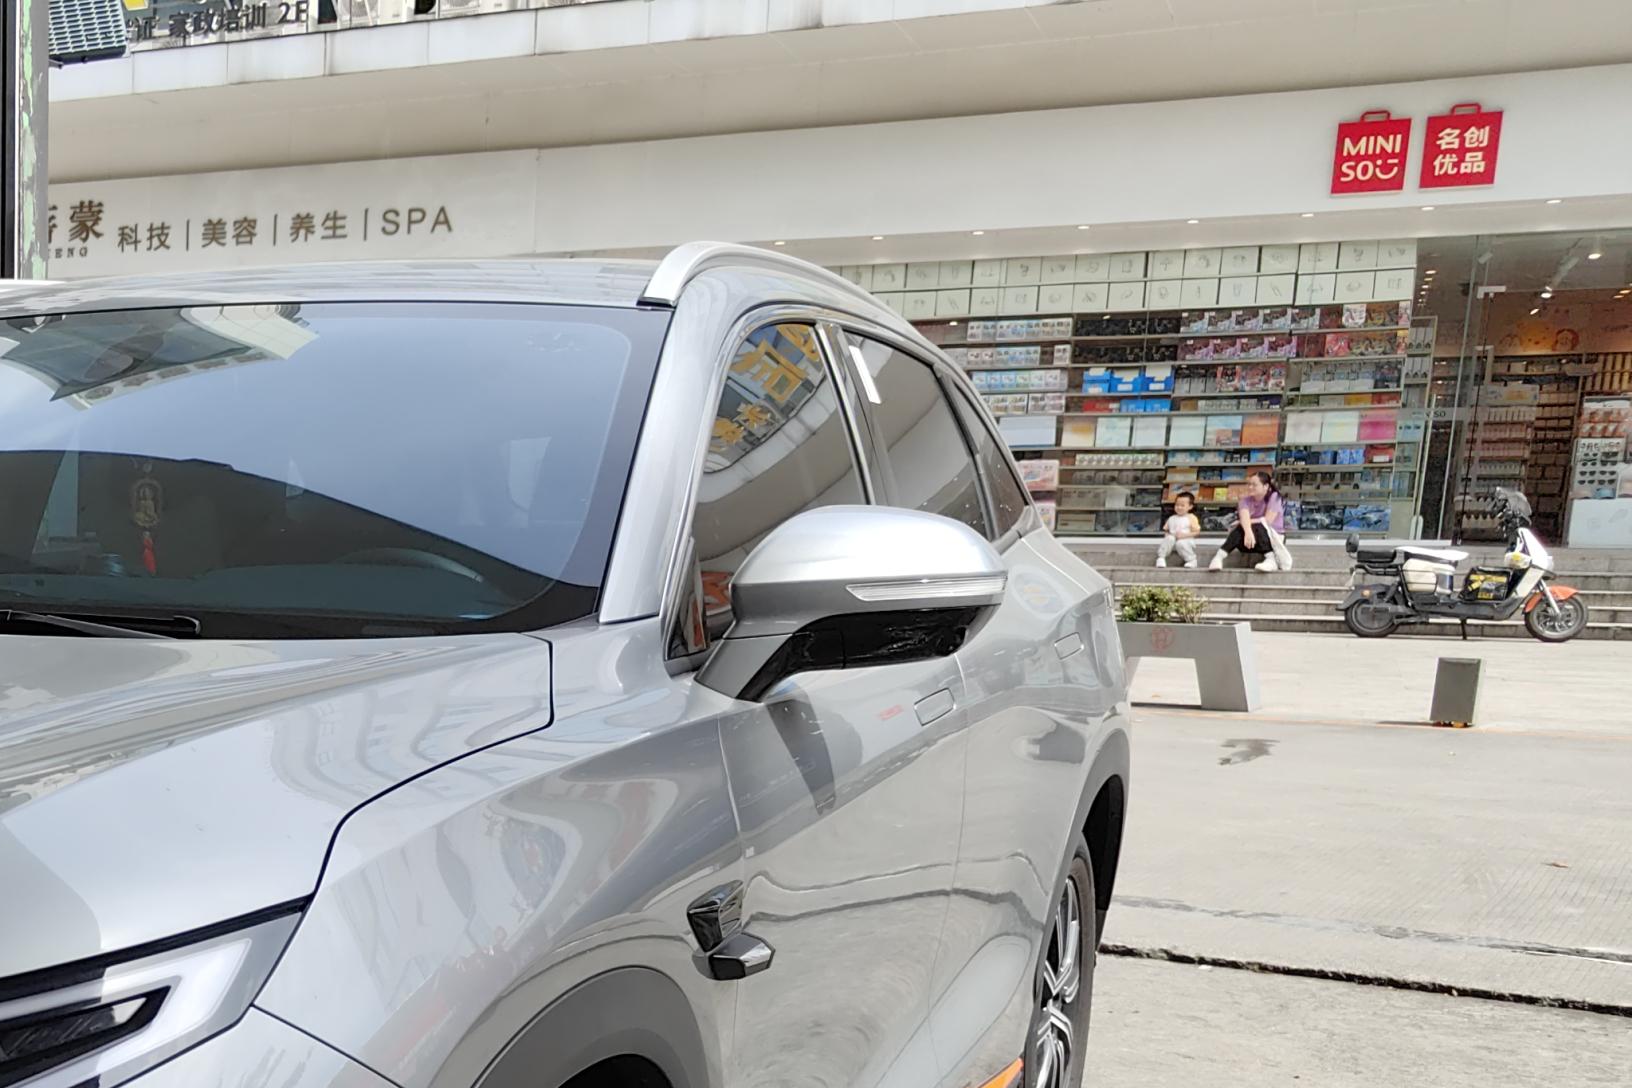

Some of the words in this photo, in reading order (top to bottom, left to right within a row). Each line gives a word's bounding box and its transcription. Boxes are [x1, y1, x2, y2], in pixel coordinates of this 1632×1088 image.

[169, 3, 268, 38] 家政培训
[1342, 133, 1403, 157] MINI
[1435, 125, 1491, 150] 名创
[1432, 151, 1487, 177] 优品
[116, 221, 172, 253] 科技
[200, 216, 259, 249] 美容
[288, 209, 348, 243] 养生
[380, 205, 453, 236] SPA
